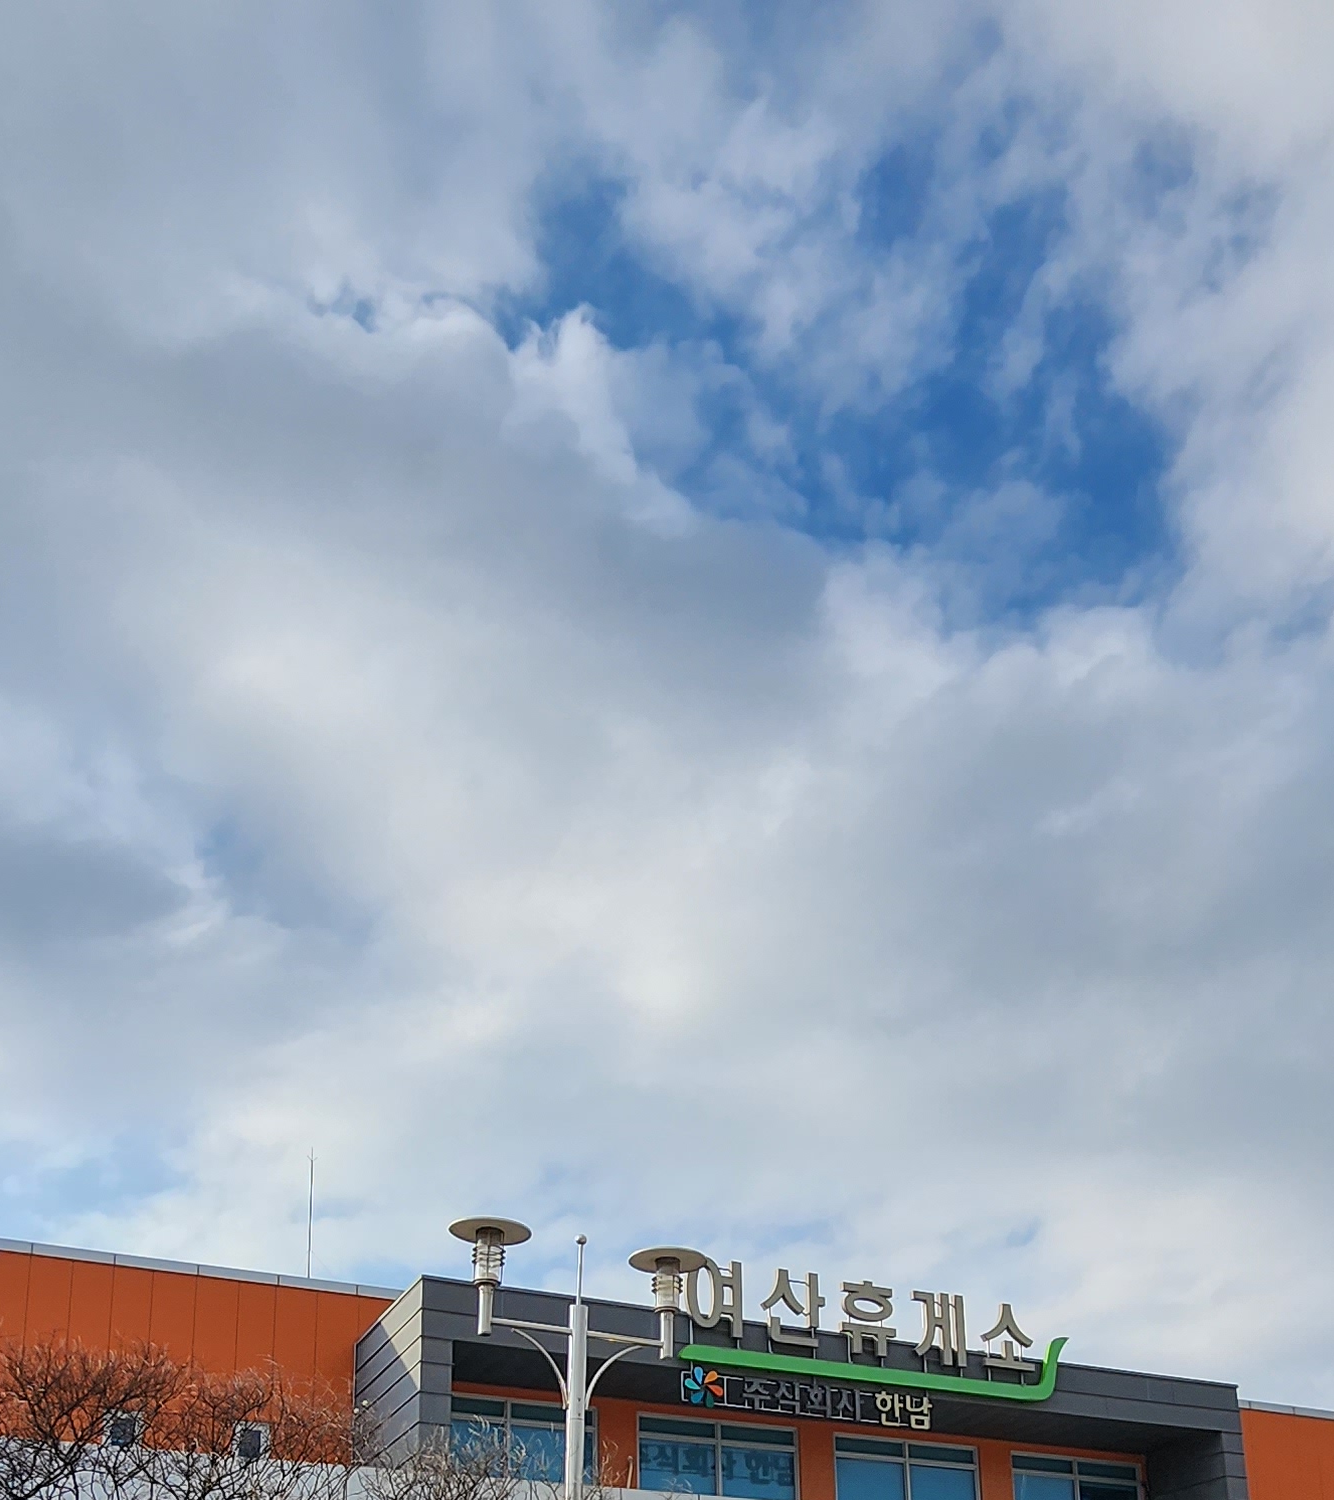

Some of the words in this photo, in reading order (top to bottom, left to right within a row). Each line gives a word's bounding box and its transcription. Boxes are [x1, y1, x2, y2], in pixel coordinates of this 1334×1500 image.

[685, 1256, 1036, 1371] 여산휴게소
[742, 1377, 865, 1421] 주식회사
[874, 1390, 933, 1430] 한남
